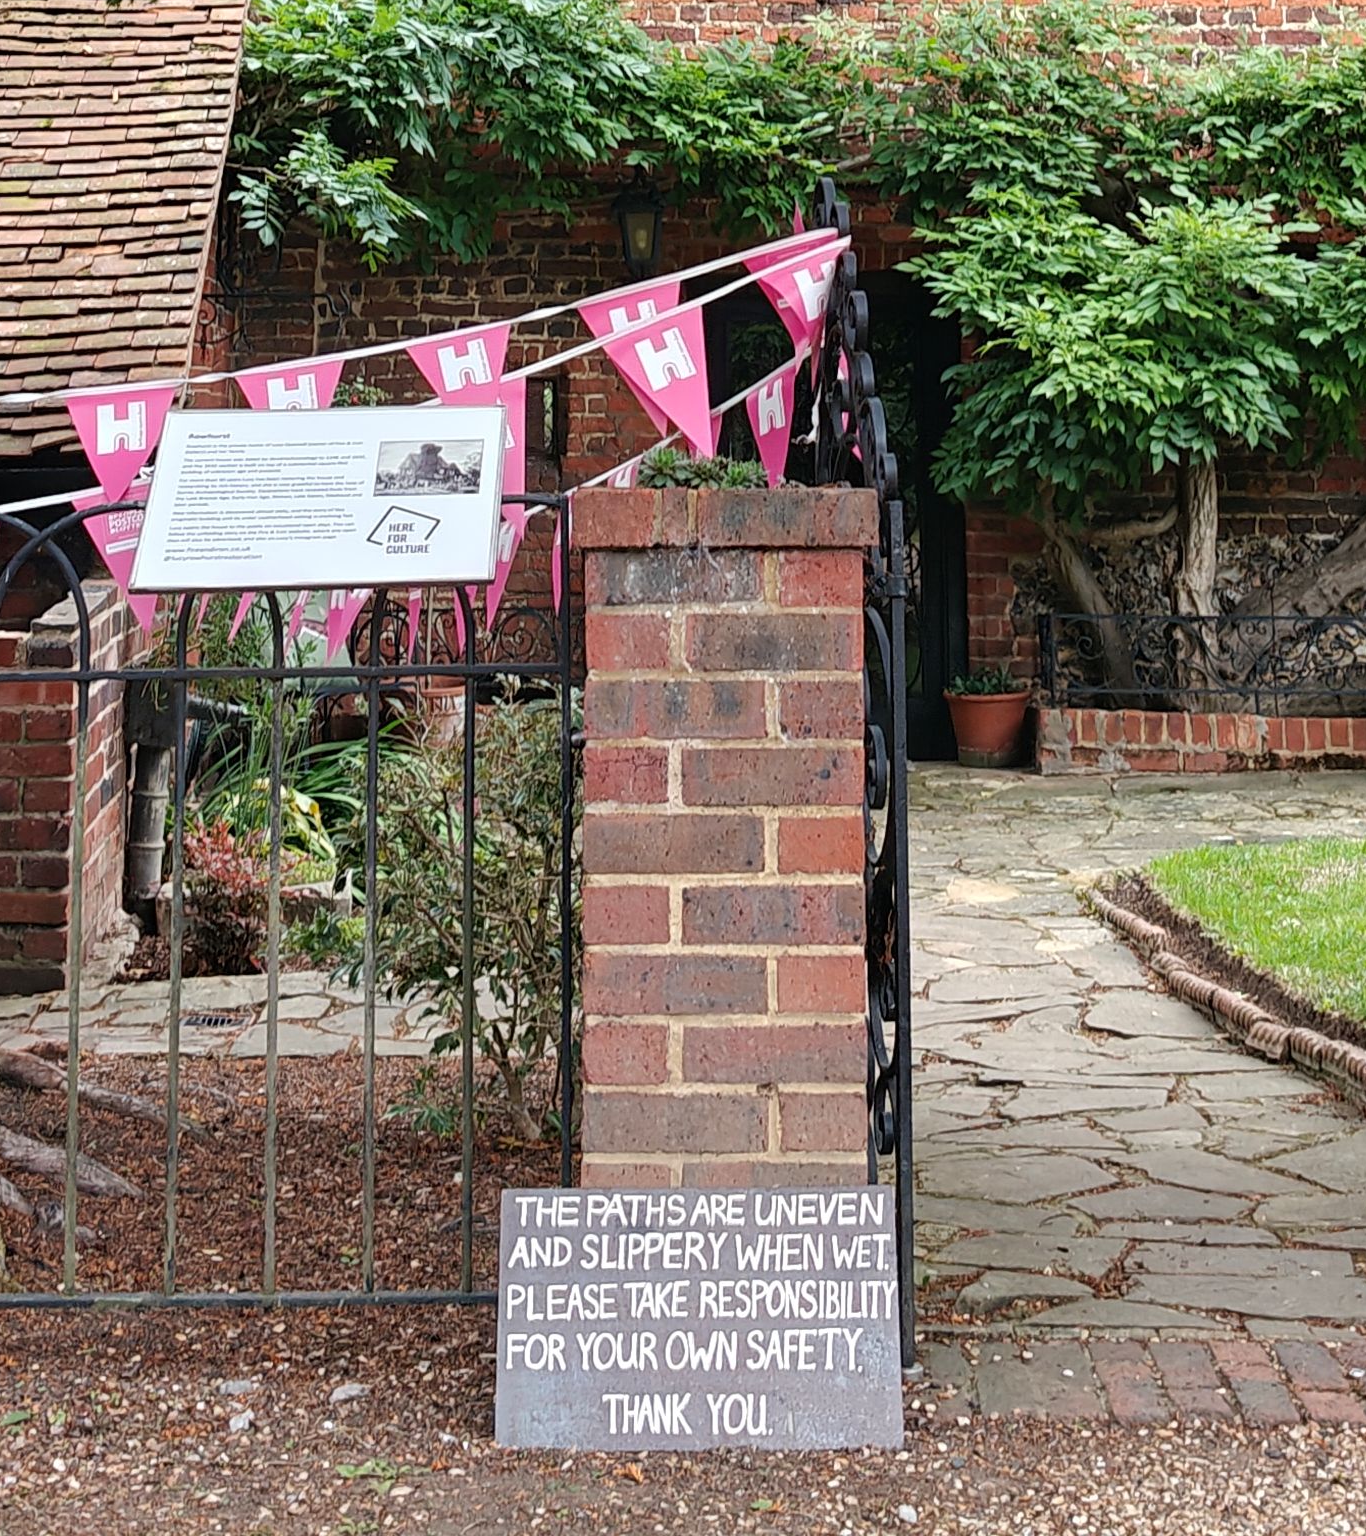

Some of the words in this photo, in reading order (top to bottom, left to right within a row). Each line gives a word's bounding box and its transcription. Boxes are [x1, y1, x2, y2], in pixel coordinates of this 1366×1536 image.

[437, 337, 493, 392] H
[634, 327, 697, 392] H
[96, 400, 146, 454] H
[387, 533, 407, 543] FOR
[388, 523, 415, 532] HERE
[386, 544, 430, 555] CULTURE
[515, 1195, 580, 1228] THE
[586, 1193, 687, 1228] PATHS
[689, 1193, 746, 1226] ARE
[754, 1193, 885, 1227] UNEVEN
[507, 1234, 572, 1269] AND
[580, 1231, 728, 1271] SLIPPERY
[734, 1233, 825, 1271] WHEN
[831, 1233, 891, 1271] WET.
[506, 1282, 618, 1321] PLEASE
[623, 1280, 690, 1320] TAKE
[698, 1279, 897, 1321] RESPONSIBILITY
[505, 1332, 566, 1371] FOR
[575, 1330, 659, 1371] YOUR
[665, 1329, 738, 1371] OWN
[746, 1327, 864, 1374] SAFETY.
[602, 1392, 692, 1435] THANK
[706, 1392, 774, 1437] YOU.
